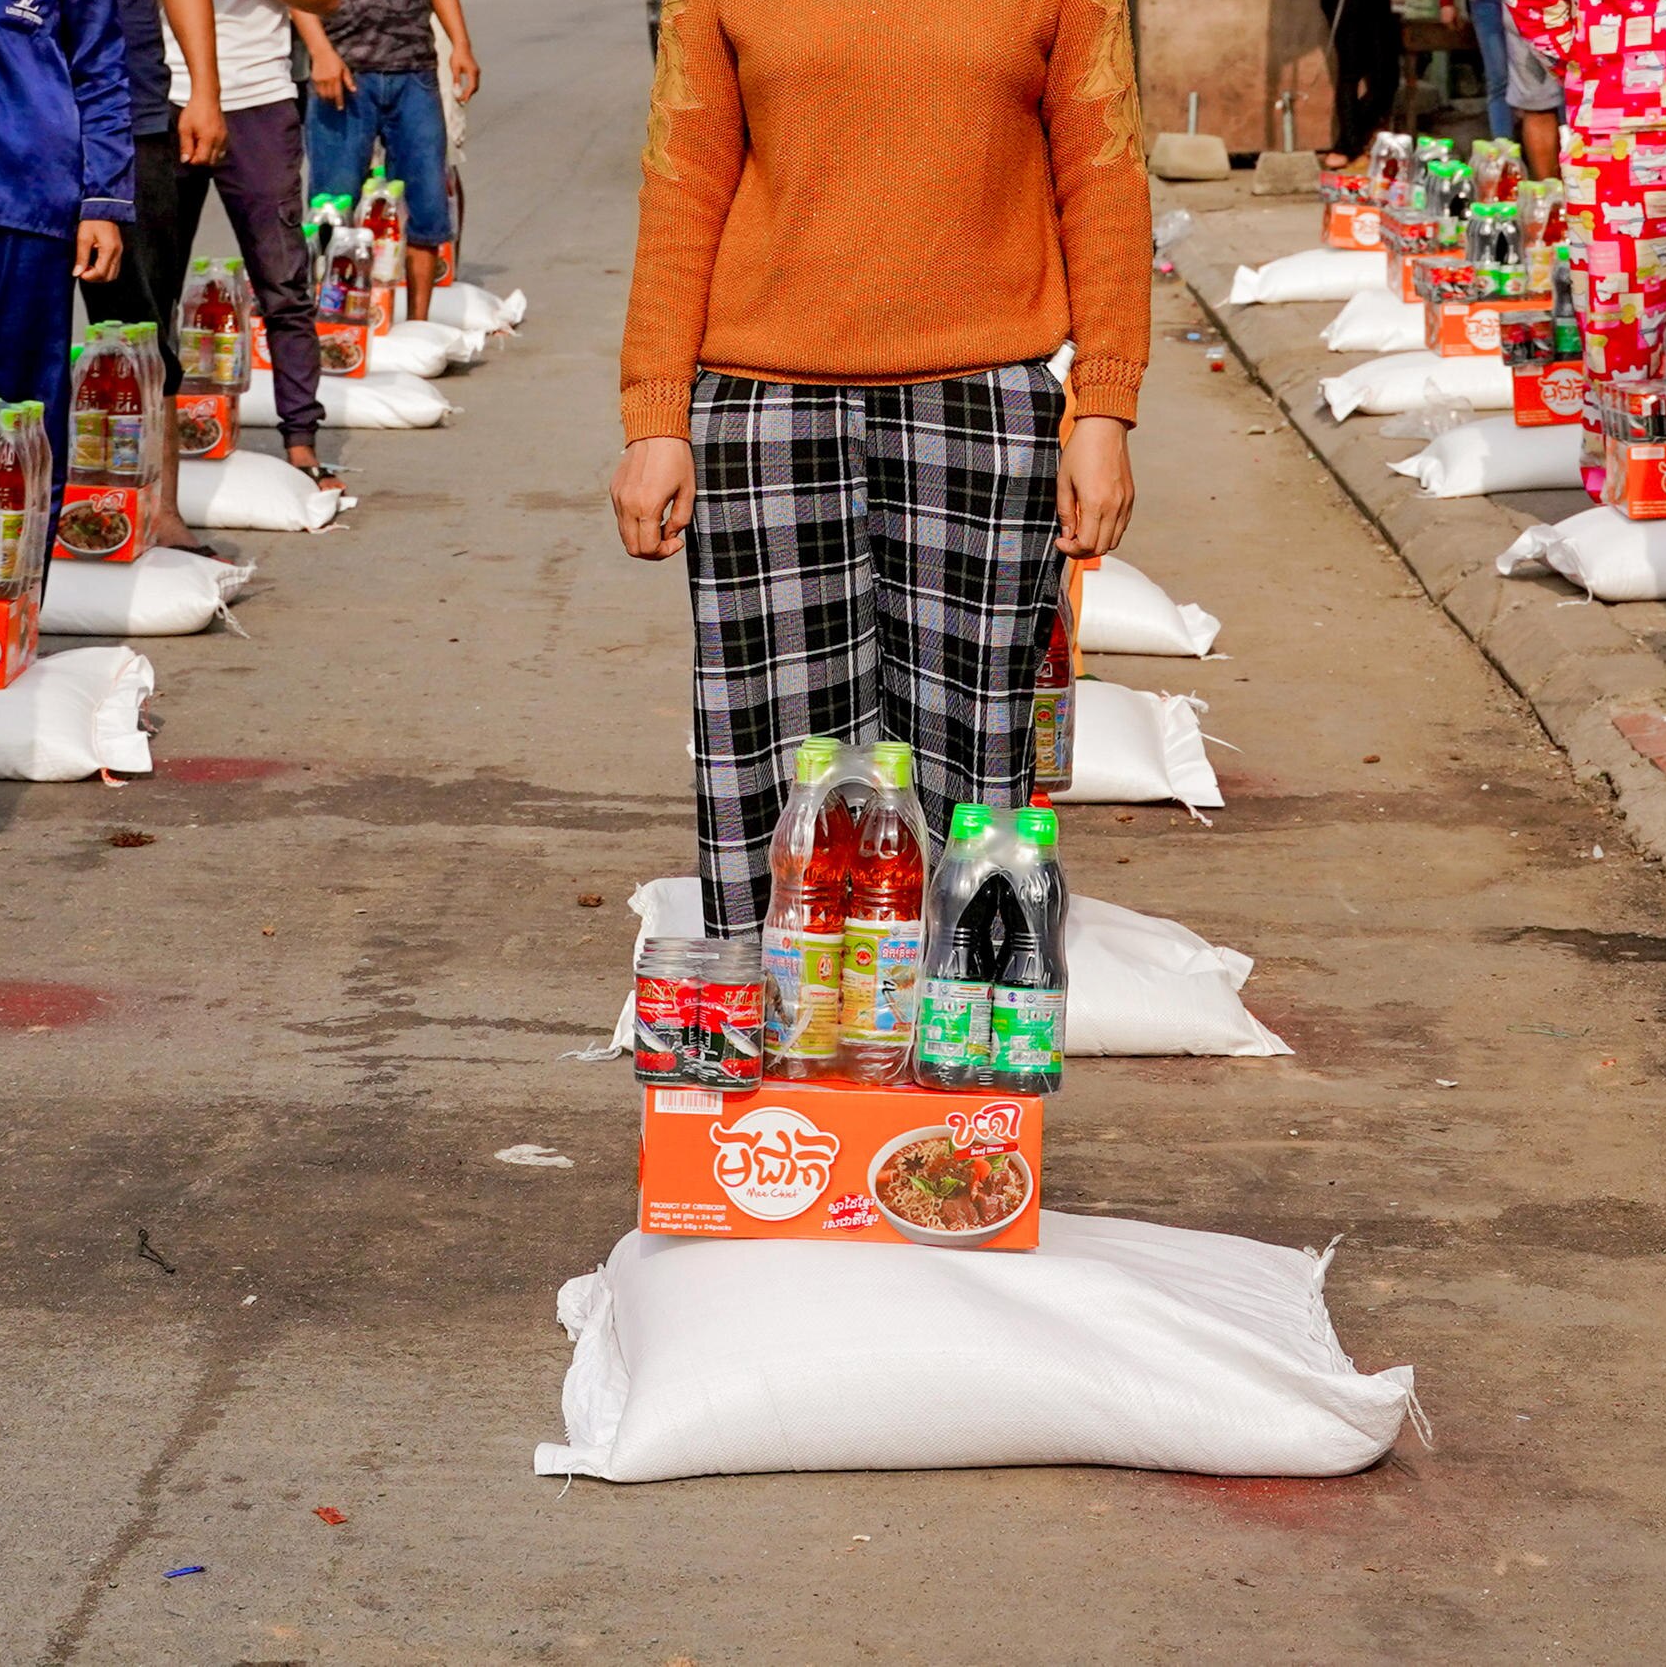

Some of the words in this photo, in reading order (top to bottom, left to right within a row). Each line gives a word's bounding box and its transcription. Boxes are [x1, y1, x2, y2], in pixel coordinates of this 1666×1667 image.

[946, 1101, 1021, 1149] ខគោ
[708, 1121, 840, 1191] មីជាតិ
